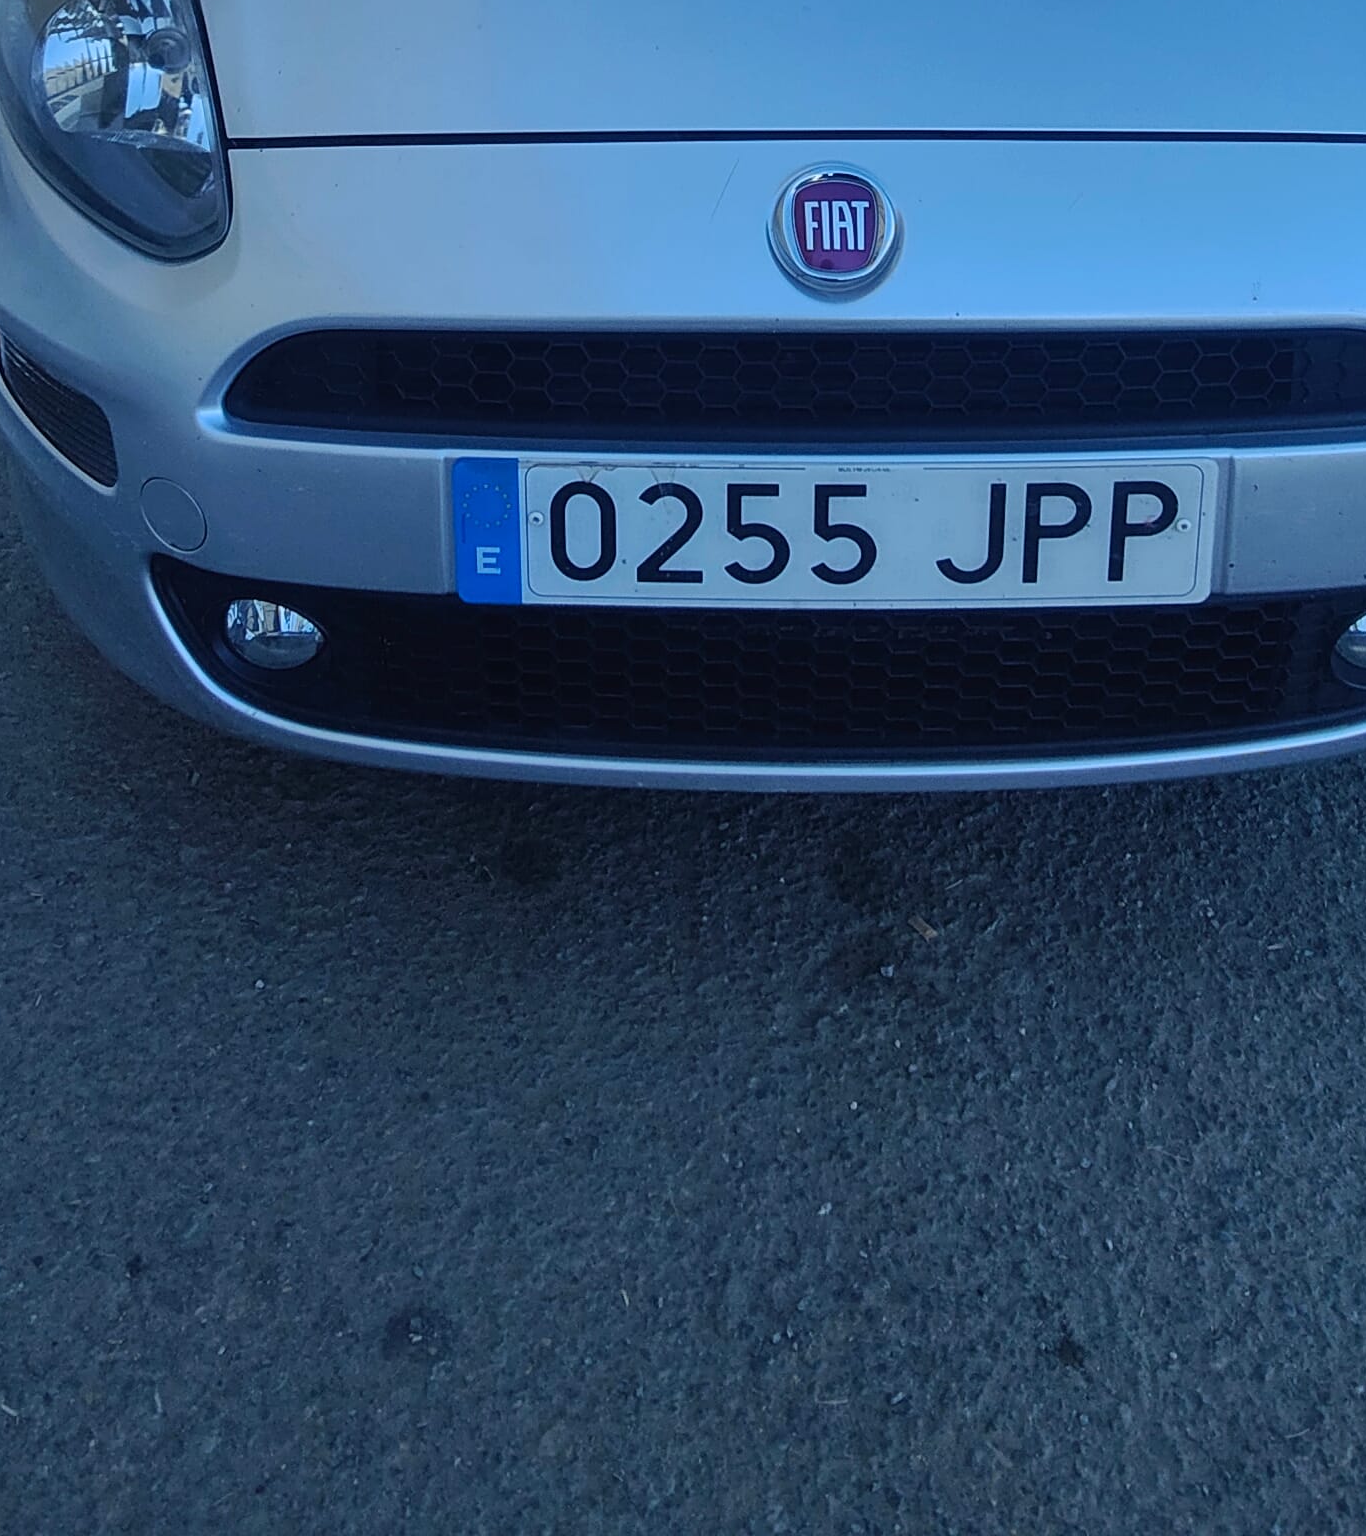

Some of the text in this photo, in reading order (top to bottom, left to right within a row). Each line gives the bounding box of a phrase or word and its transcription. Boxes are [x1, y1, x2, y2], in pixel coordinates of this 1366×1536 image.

[804, 200, 870, 251] FIAT
[548, 480, 1180, 585] 0255 JPP
[476, 546, 501, 575] E
